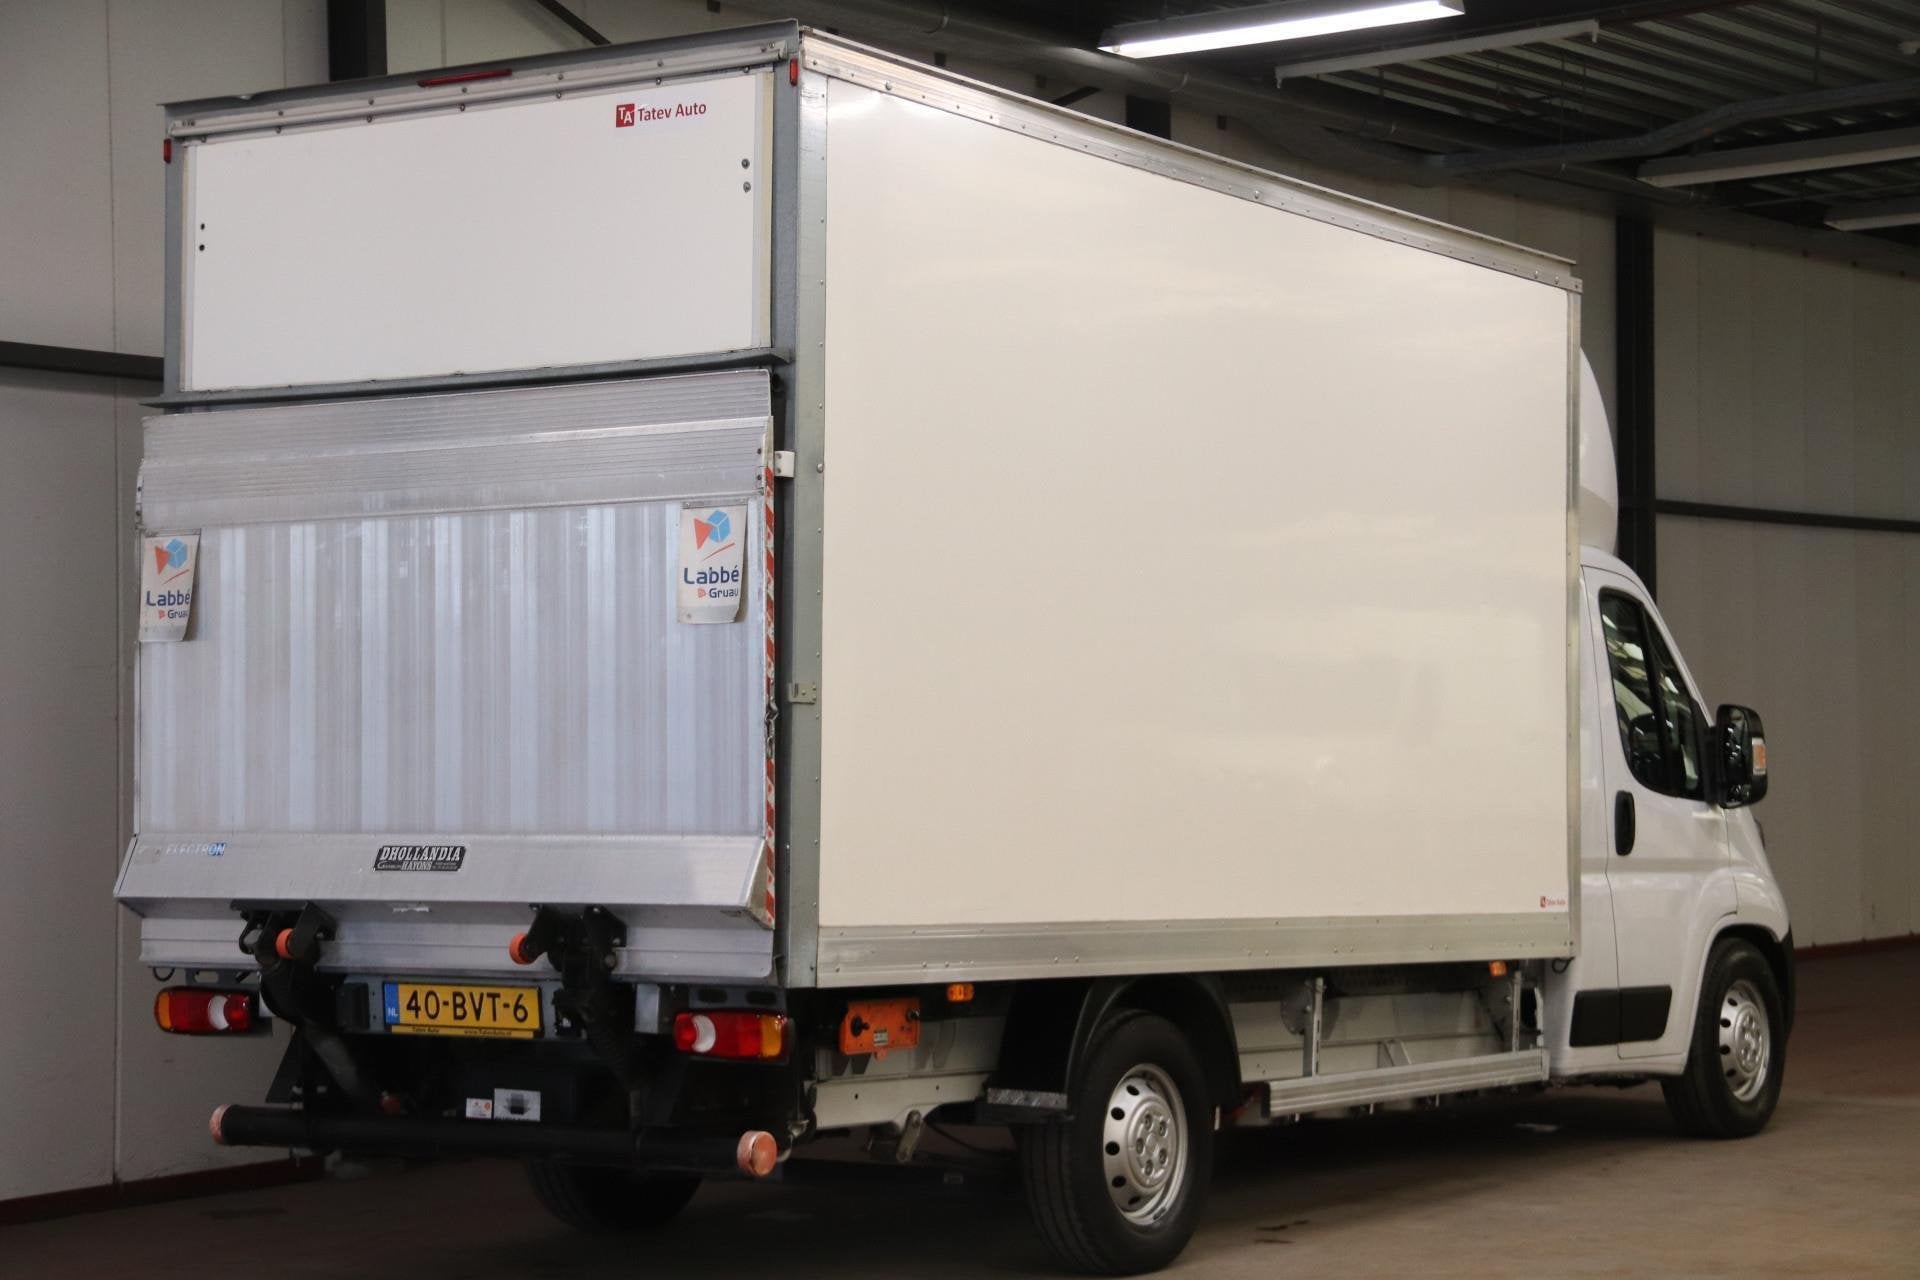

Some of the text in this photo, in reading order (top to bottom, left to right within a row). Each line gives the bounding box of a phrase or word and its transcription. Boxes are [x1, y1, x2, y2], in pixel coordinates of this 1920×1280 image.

[637, 107, 672, 122] Tatev
[675, 103, 707, 118] Auto
[683, 564, 740, 585] Labbé
[146, 588, 192, 607] Labbé
[709, 587, 739, 599] Gruau
[380, 846, 461, 861] DHOLLANDIA
[387, 1007, 399, 1017] NL
[406, 989, 529, 1023] 40-BVT-6
